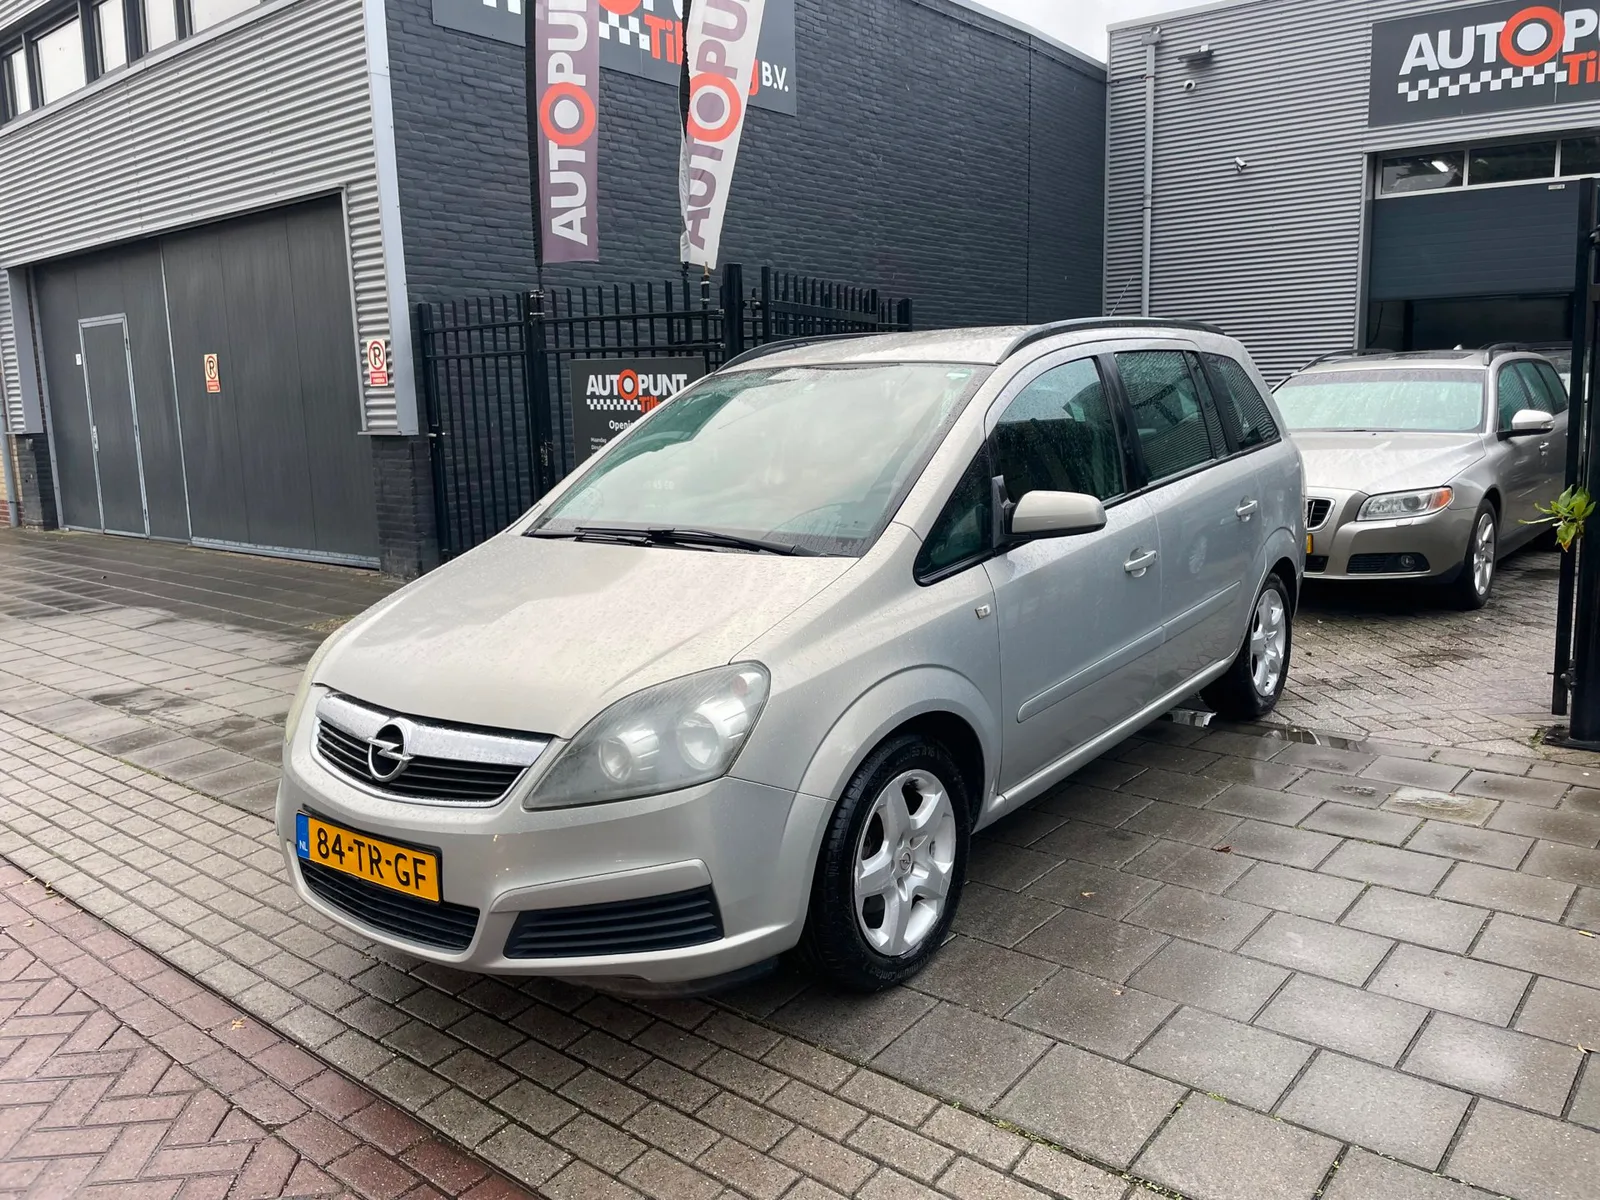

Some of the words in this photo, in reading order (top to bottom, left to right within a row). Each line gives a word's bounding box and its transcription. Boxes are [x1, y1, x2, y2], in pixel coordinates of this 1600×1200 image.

[1399, 6, 1600, 75] AUTOP
[762, 61, 789, 92] B.V.
[1562, 50, 1600, 86] Ti
[686, 0, 749, 250] AUTOPU
[586, 369, 688, 400] AUTOPUNT
[608, 420, 635, 431] Openi
[299, 839, 309, 852] NL
[317, 827, 426, 890] 84-TR-GF
